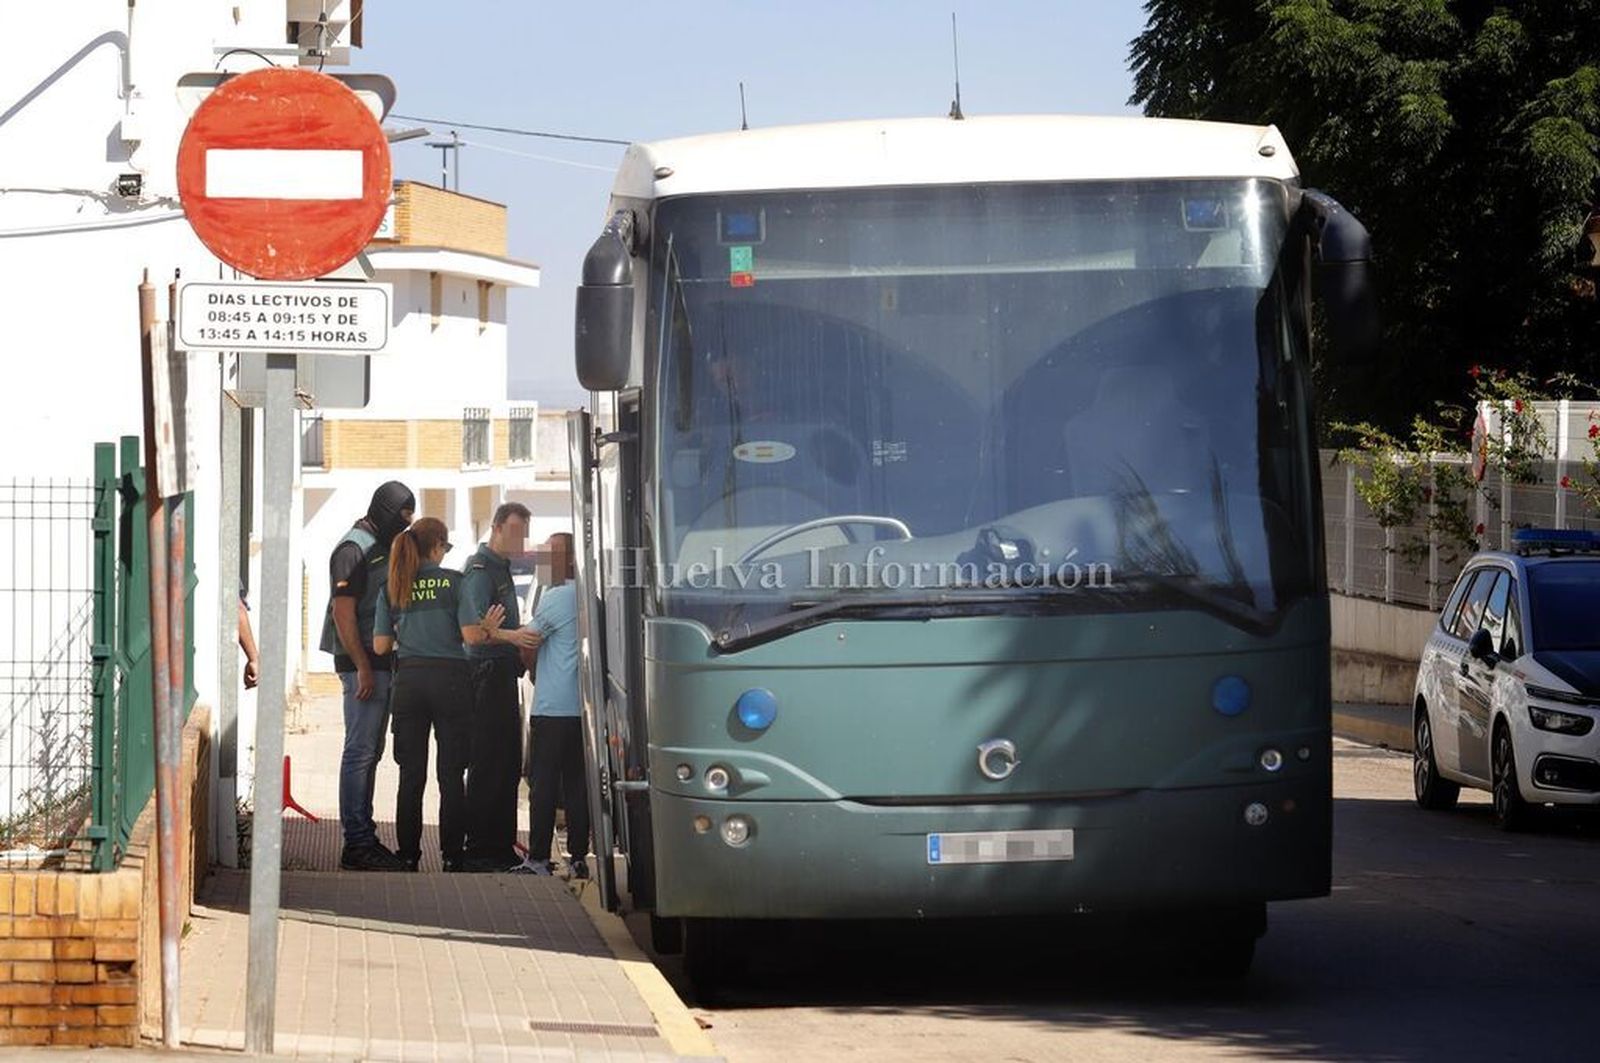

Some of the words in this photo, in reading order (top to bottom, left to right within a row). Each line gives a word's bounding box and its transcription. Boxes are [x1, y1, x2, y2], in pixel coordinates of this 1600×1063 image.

[208, 293, 246, 306] DIAS
[252, 294, 332, 308] LECTIVOS
[338, 296, 359, 308] DE
[208, 311, 251, 323] 08:45
[257, 312, 267, 323] A
[273, 312, 316, 324] 09:15
[322, 313, 332, 324] Y
[338, 313, 358, 325] DE
[199, 328, 241, 340] 13:45
[246, 329, 257, 340] A
[264, 329, 306, 341] 14:15
[311, 330, 368, 343] HORAS
[411, 578, 451, 590] ARDIA
[411, 589, 437, 601] IVIL
